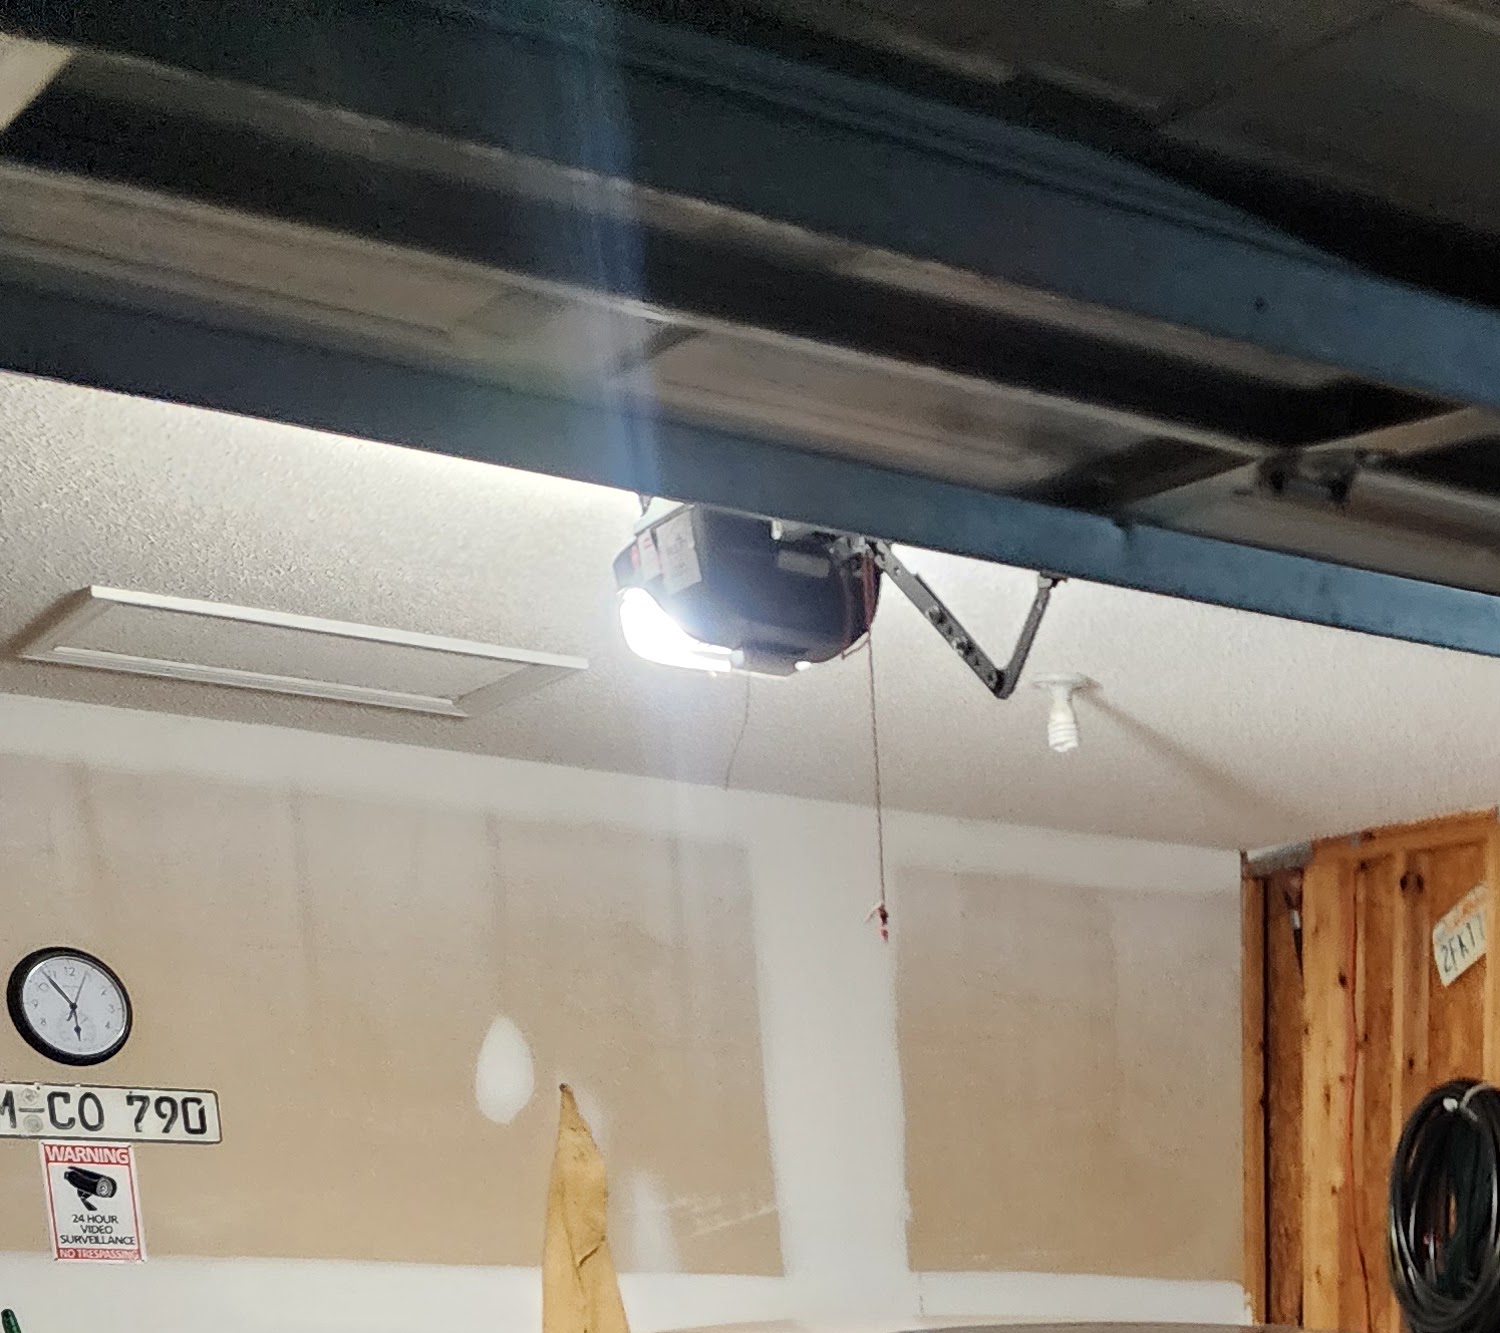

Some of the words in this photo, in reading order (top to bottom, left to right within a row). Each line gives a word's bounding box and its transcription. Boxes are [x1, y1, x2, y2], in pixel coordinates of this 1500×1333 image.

[126, 1093, 208, 1135] 790
[45, 1147, 130, 1165] WARNING
[72, 1214, 85, 1224] 24
[87, 1214, 119, 1225] HOUR
[80, 1225, 114, 1235] VIDEO
[60, 1235, 136, 1246] SURVEILLANCE
[60, 1249, 75, 1259] NO
[77, 1249, 140, 1260] TRESPASSING
